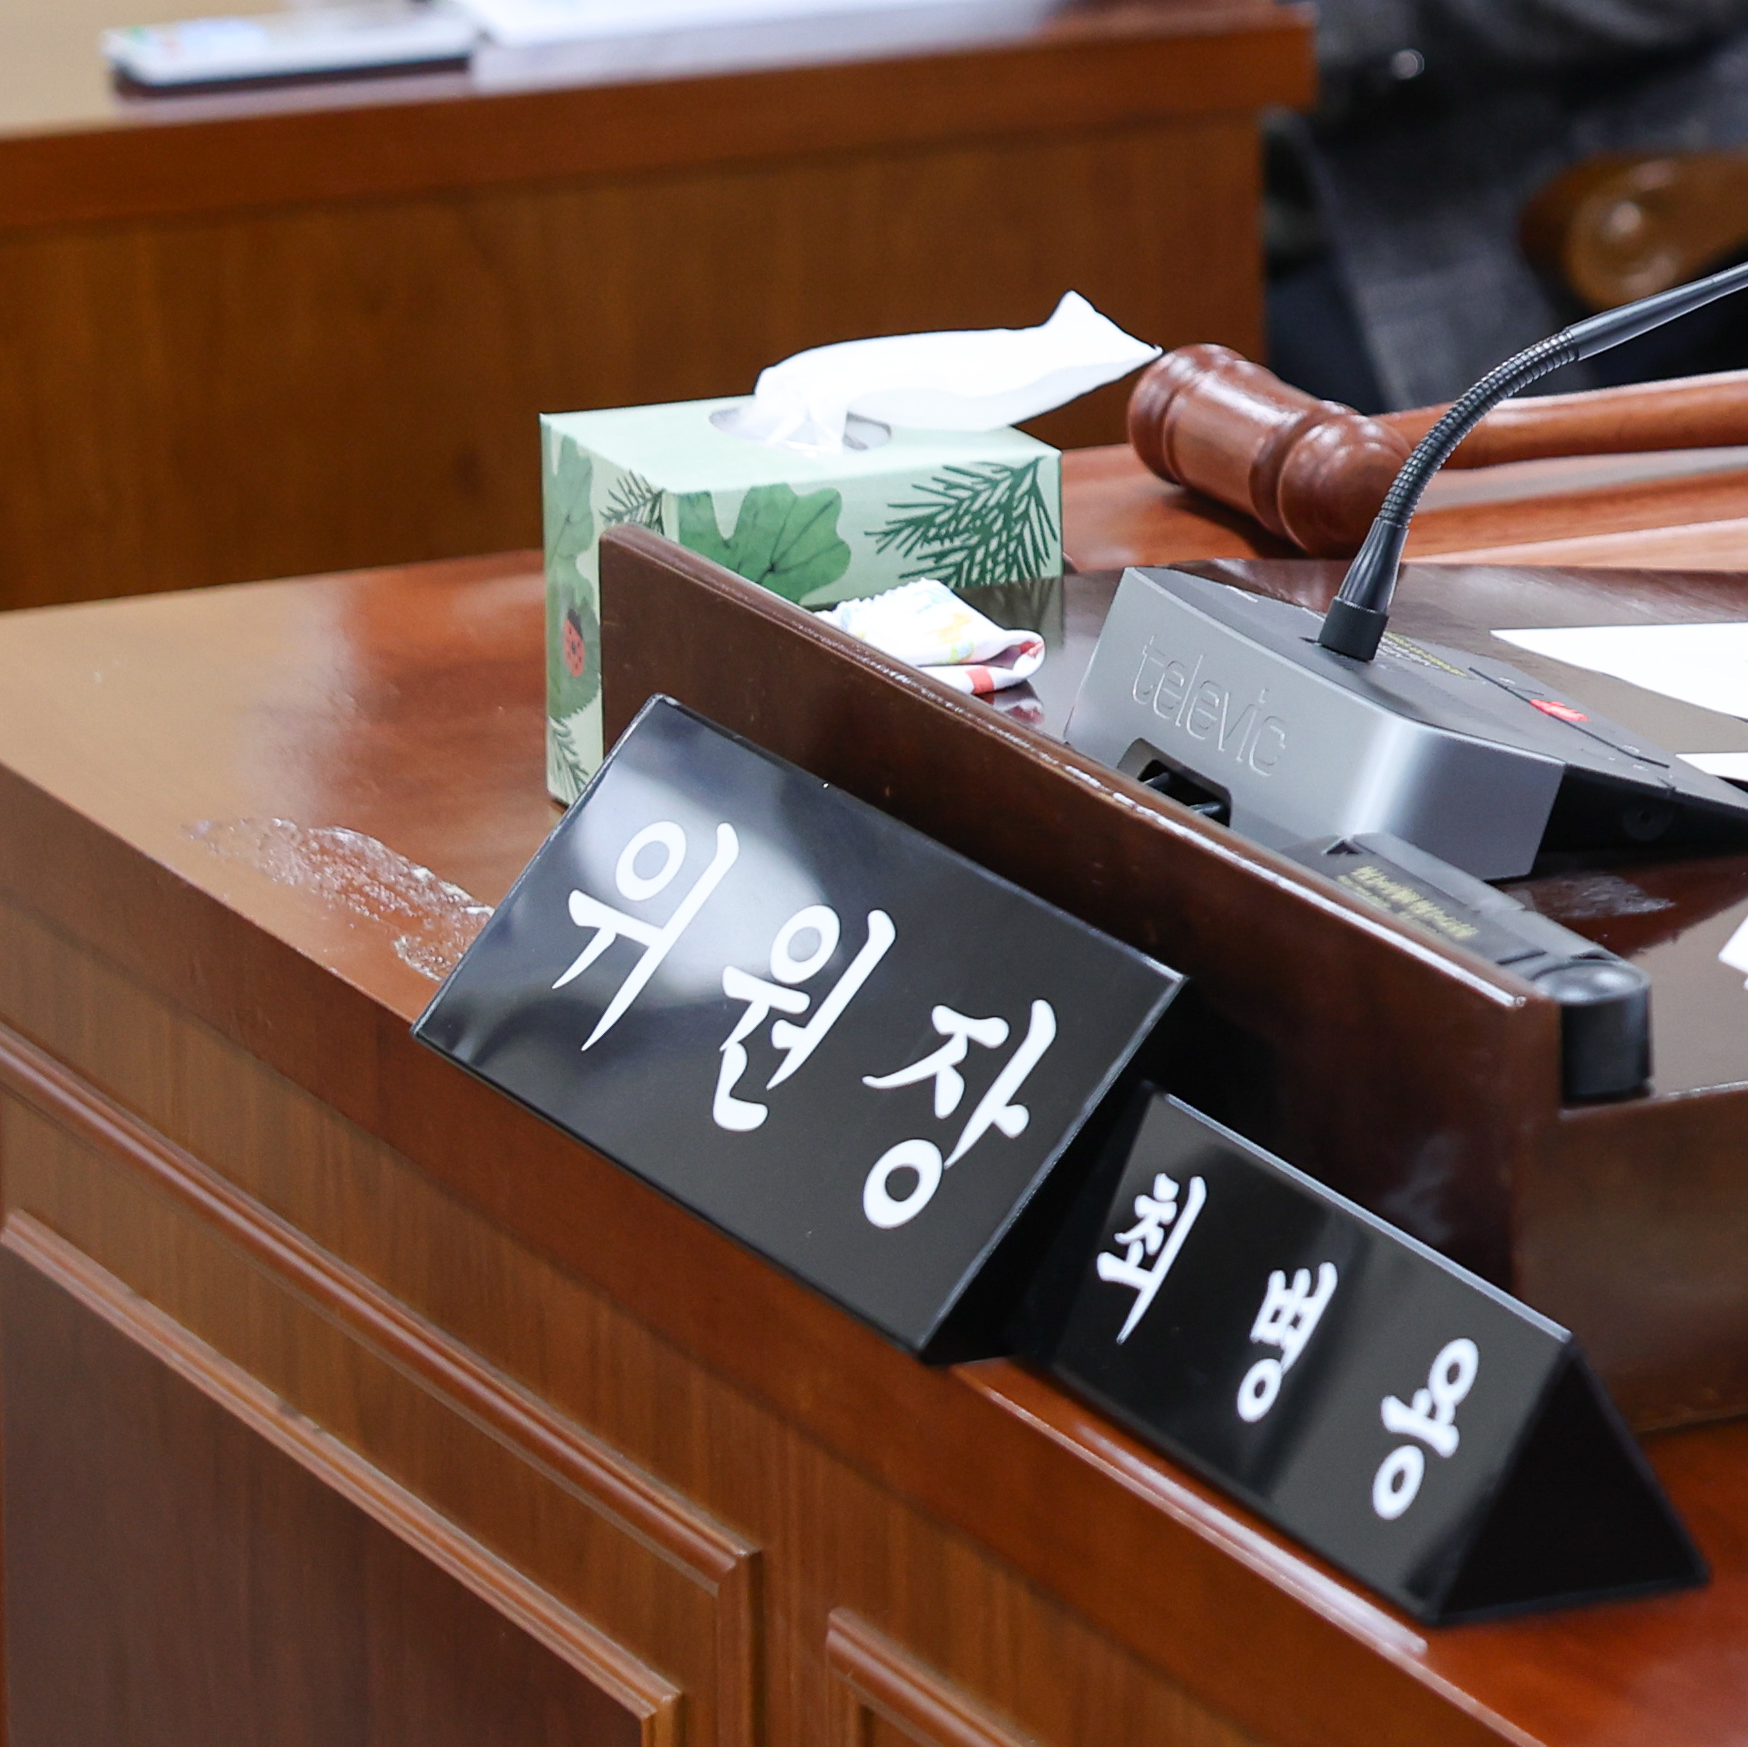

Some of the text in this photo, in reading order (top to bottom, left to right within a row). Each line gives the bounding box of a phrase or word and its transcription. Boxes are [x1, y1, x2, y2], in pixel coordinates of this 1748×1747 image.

[1132, 636, 1287, 776] televic
[552, 820, 1056, 1228] 위원장
[1097, 1173, 1479, 1519] 최병용
